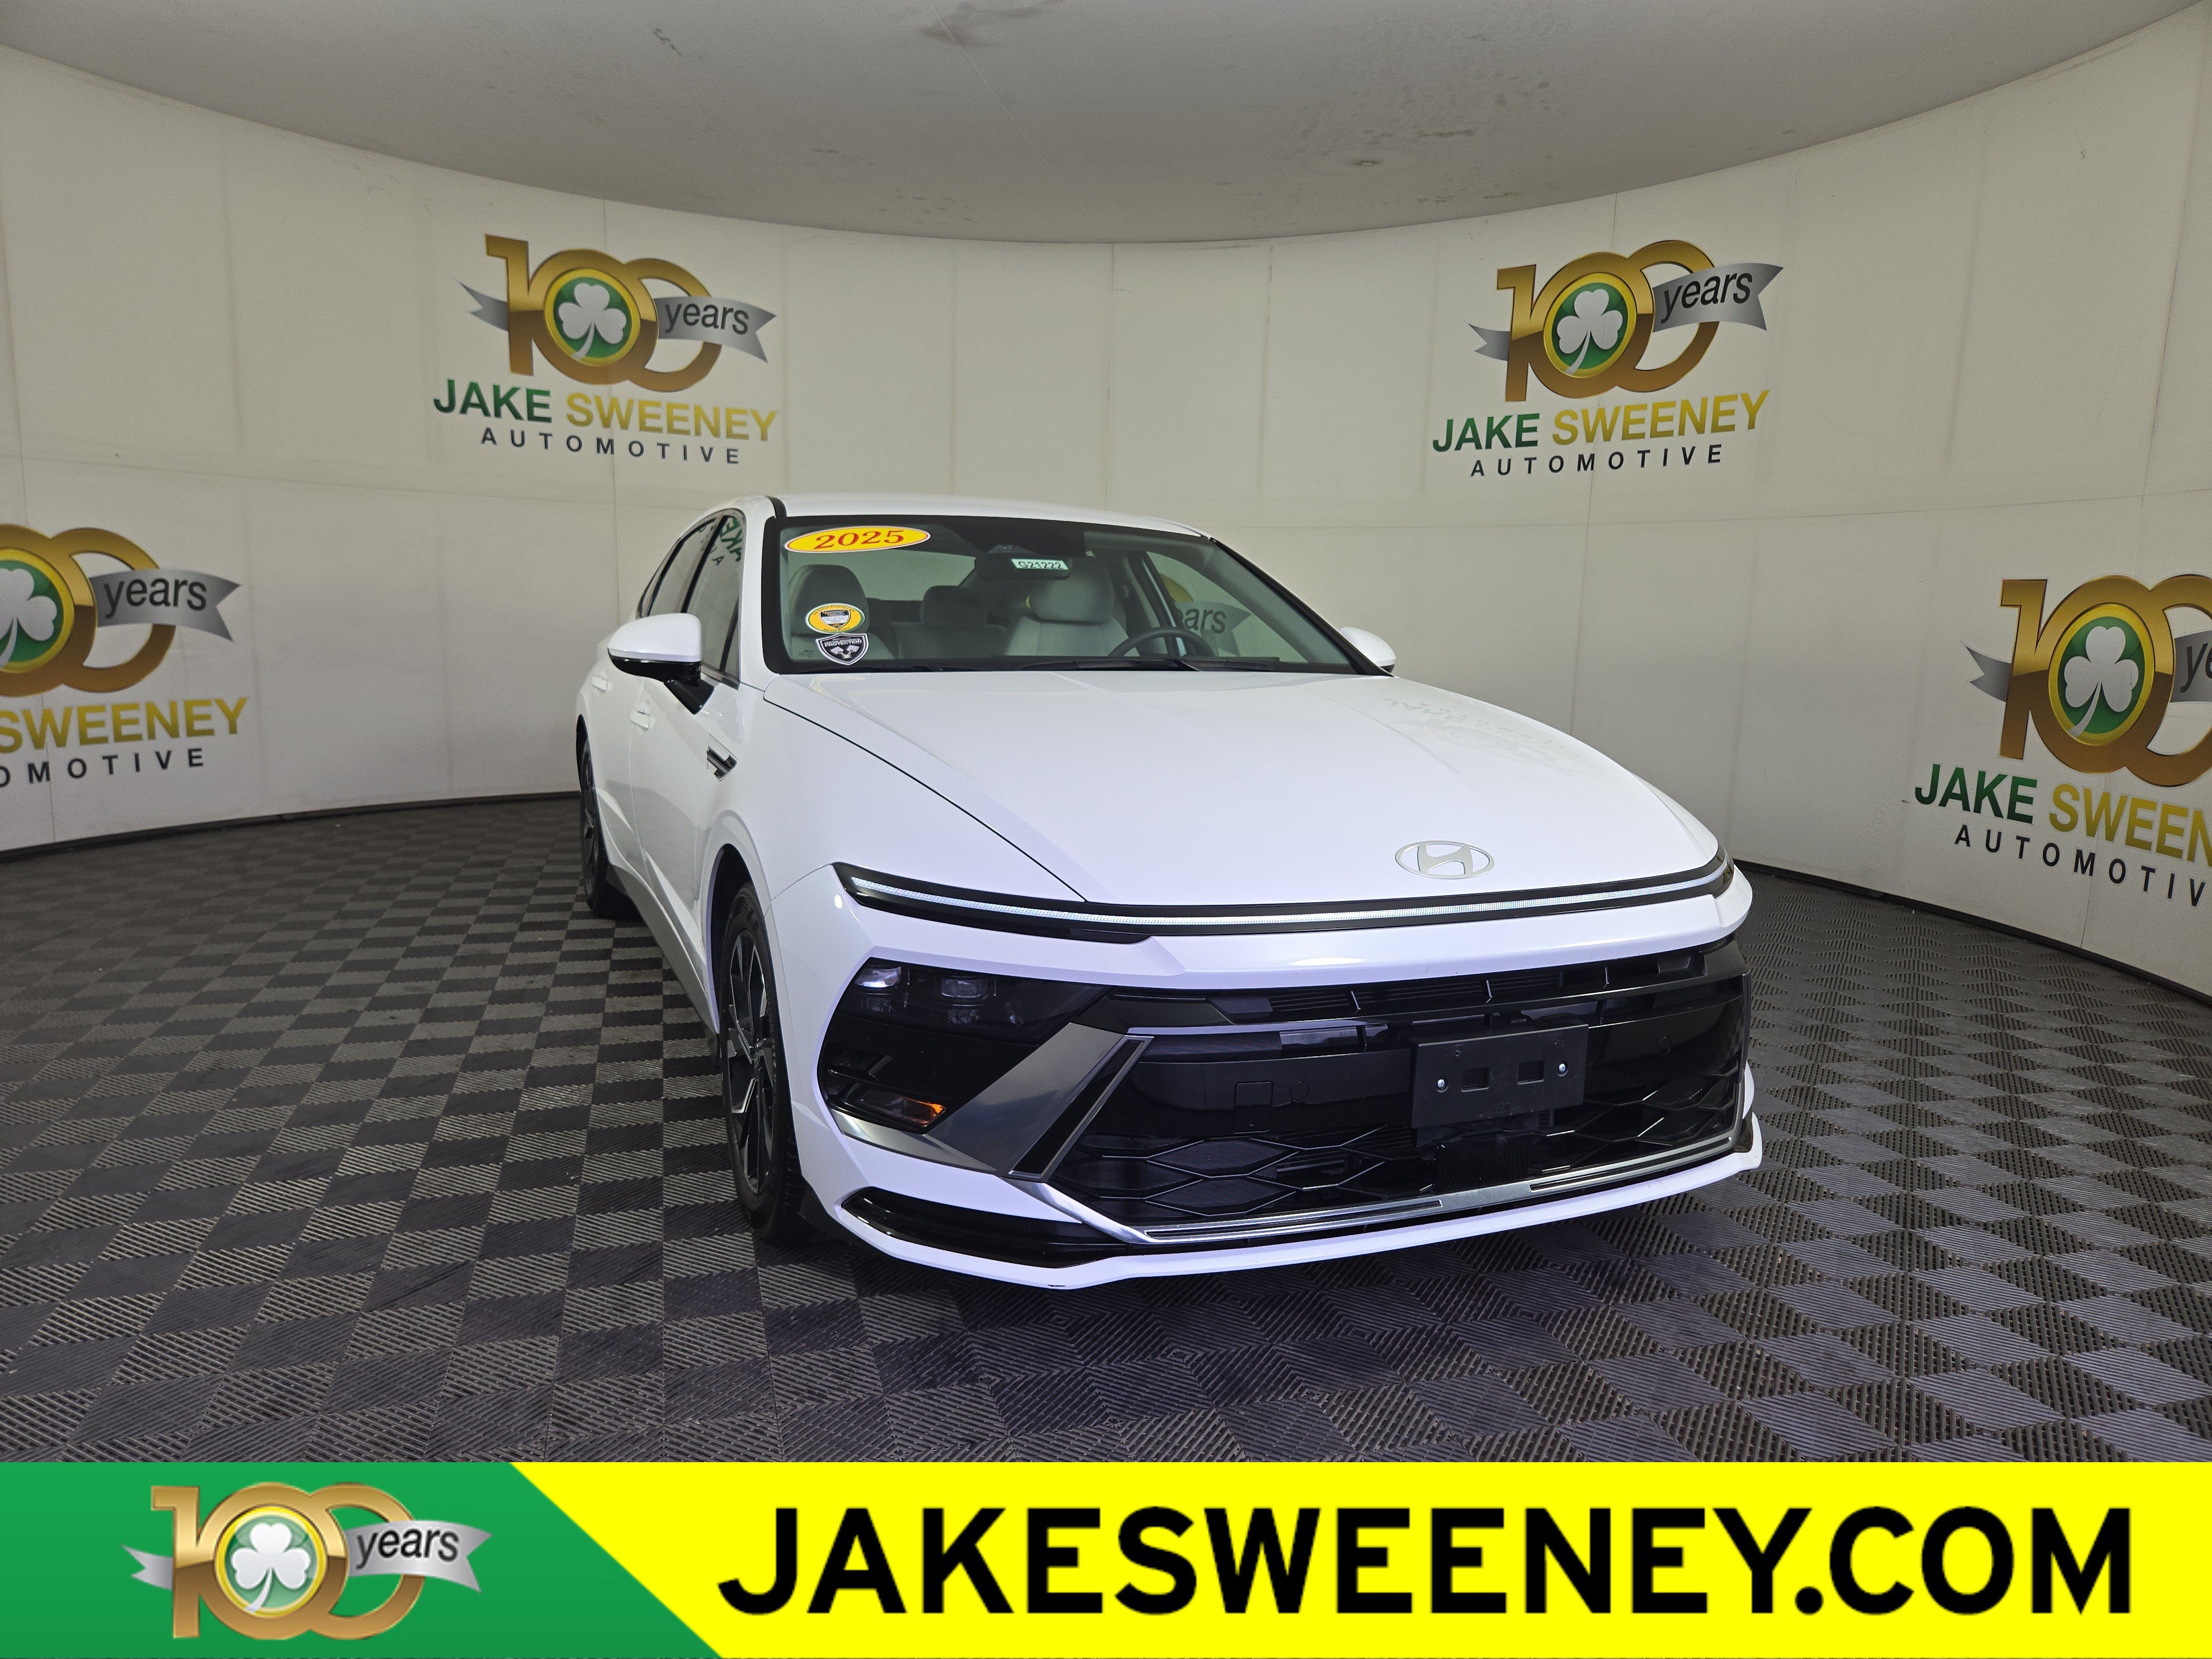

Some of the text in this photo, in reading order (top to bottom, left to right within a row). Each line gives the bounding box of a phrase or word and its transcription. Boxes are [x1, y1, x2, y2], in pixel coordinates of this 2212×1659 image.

[665, 301, 749, 335] years
[1661, 271, 1752, 324] years
[433, 378, 777, 441] JAKE SWEENEY
[1433, 390, 1770, 452] JAKE SWEENEY
[481, 428, 738, 464] AUTOMOTIVE
[1470, 444, 1722, 477] AUTOMOTIVE
[814, 530, 905, 550] 2025
[104, 577, 207, 619] years
[1914, 763, 2038, 825] JAKE
